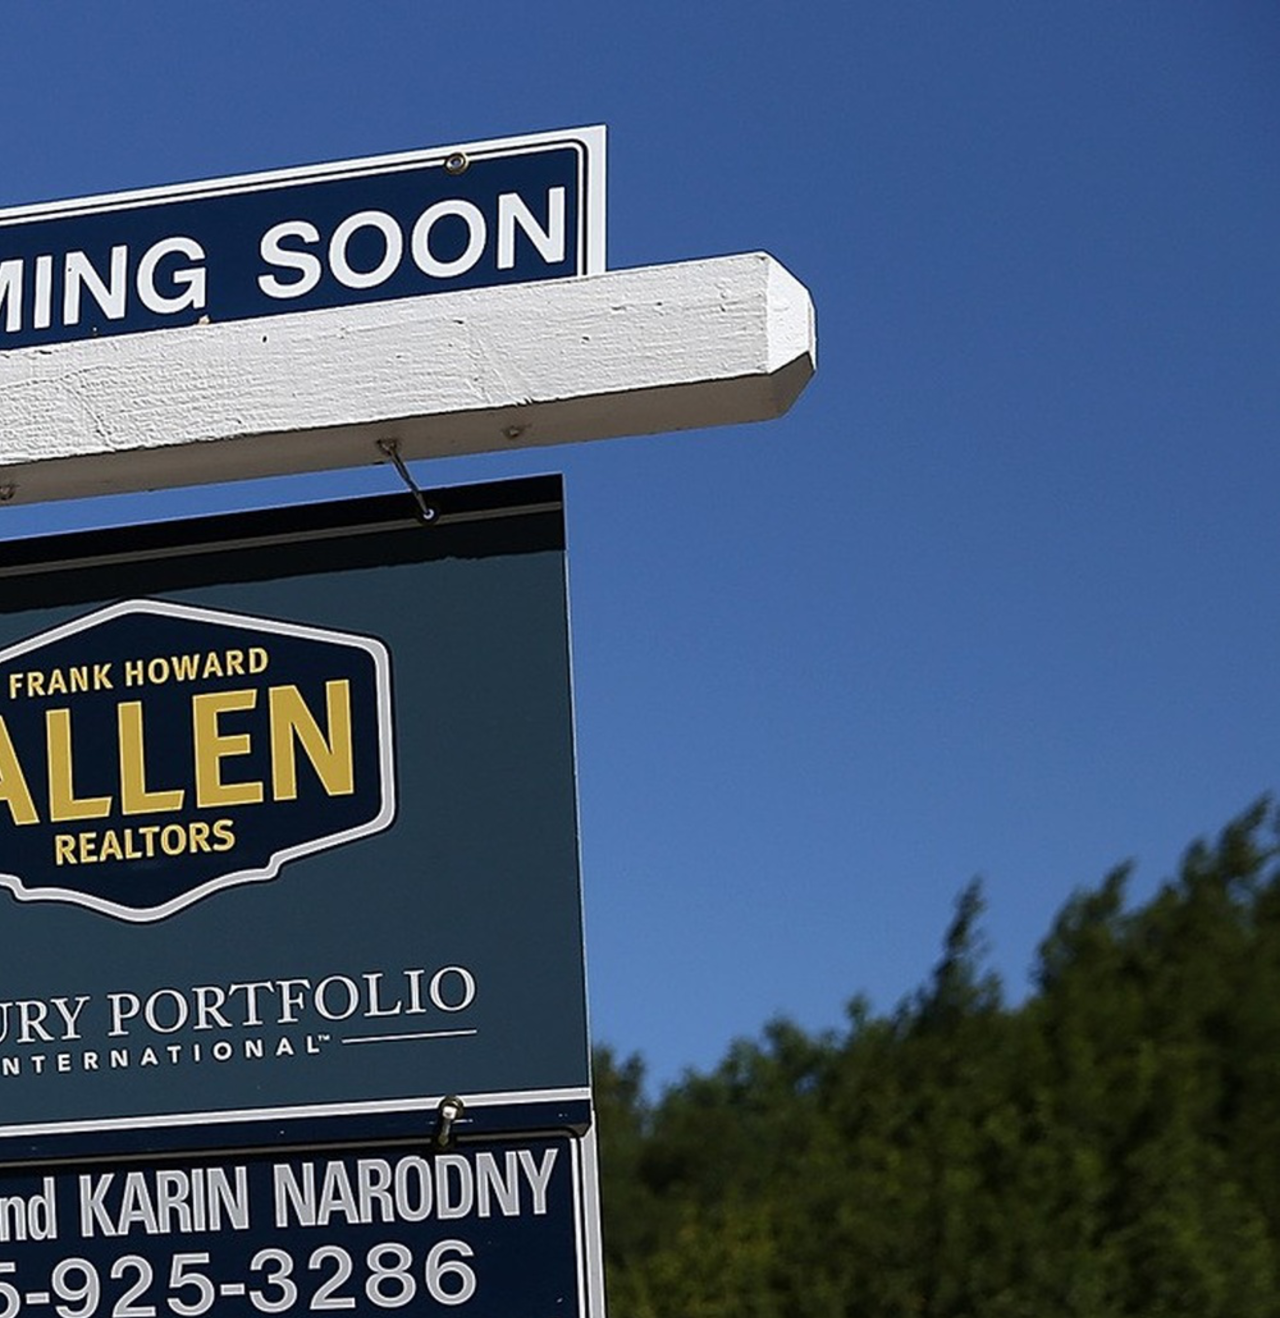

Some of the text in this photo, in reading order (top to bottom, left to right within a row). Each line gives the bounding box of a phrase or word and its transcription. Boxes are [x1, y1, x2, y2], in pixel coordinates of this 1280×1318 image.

[258, 186, 566, 300] SOON
[9, 647, 269, 700] FRANK HOWARD
[55, 817, 236, 866] REALTORS
[108, 965, 477, 1036] PORTFOLIO
[80, 1166, 247, 1238] KARIN
[274, 1147, 558, 1229] NARODNY
